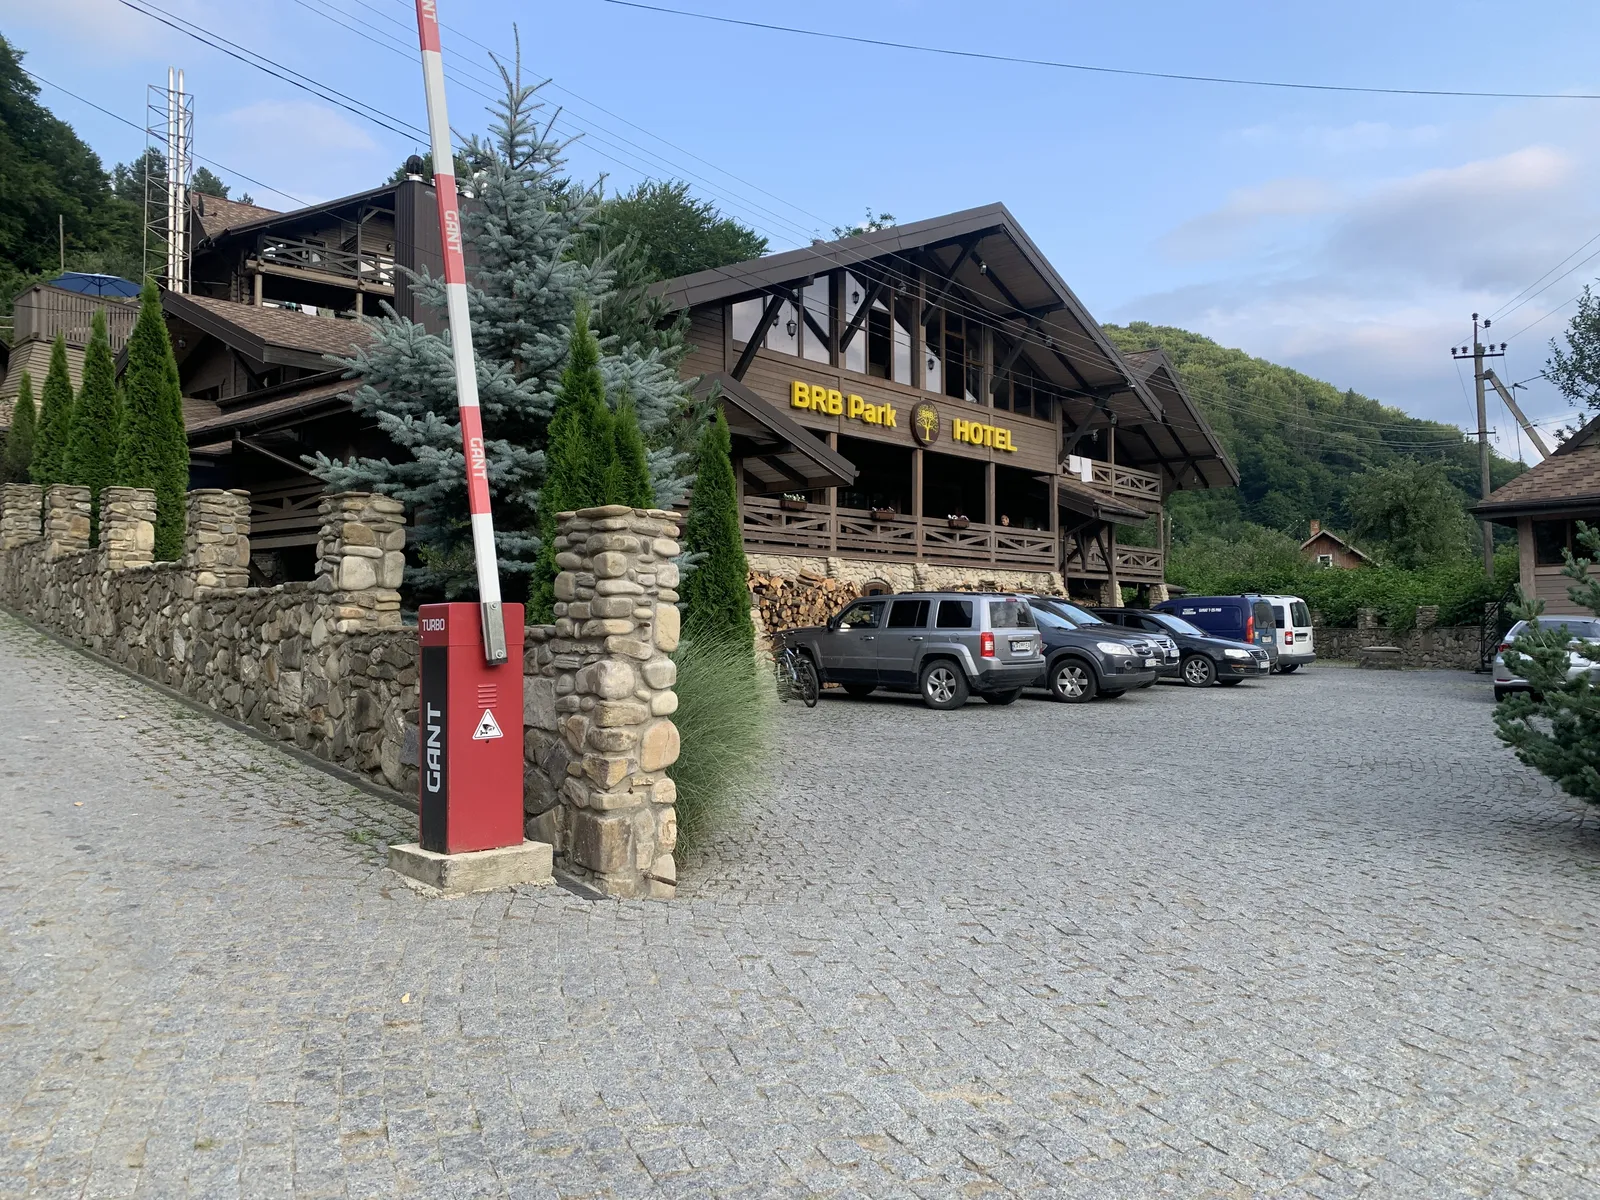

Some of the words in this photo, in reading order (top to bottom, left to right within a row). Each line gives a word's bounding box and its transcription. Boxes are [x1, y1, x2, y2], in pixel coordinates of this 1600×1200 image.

[443, 210, 462, 254] GANT
[791, 380, 843, 415] BRB
[847, 394, 897, 427] Park
[952, 418, 1017, 452] HOTEL
[470, 437, 486, 480] GANT
[422, 619, 445, 631] TURBO
[427, 702, 441, 793] GANT
